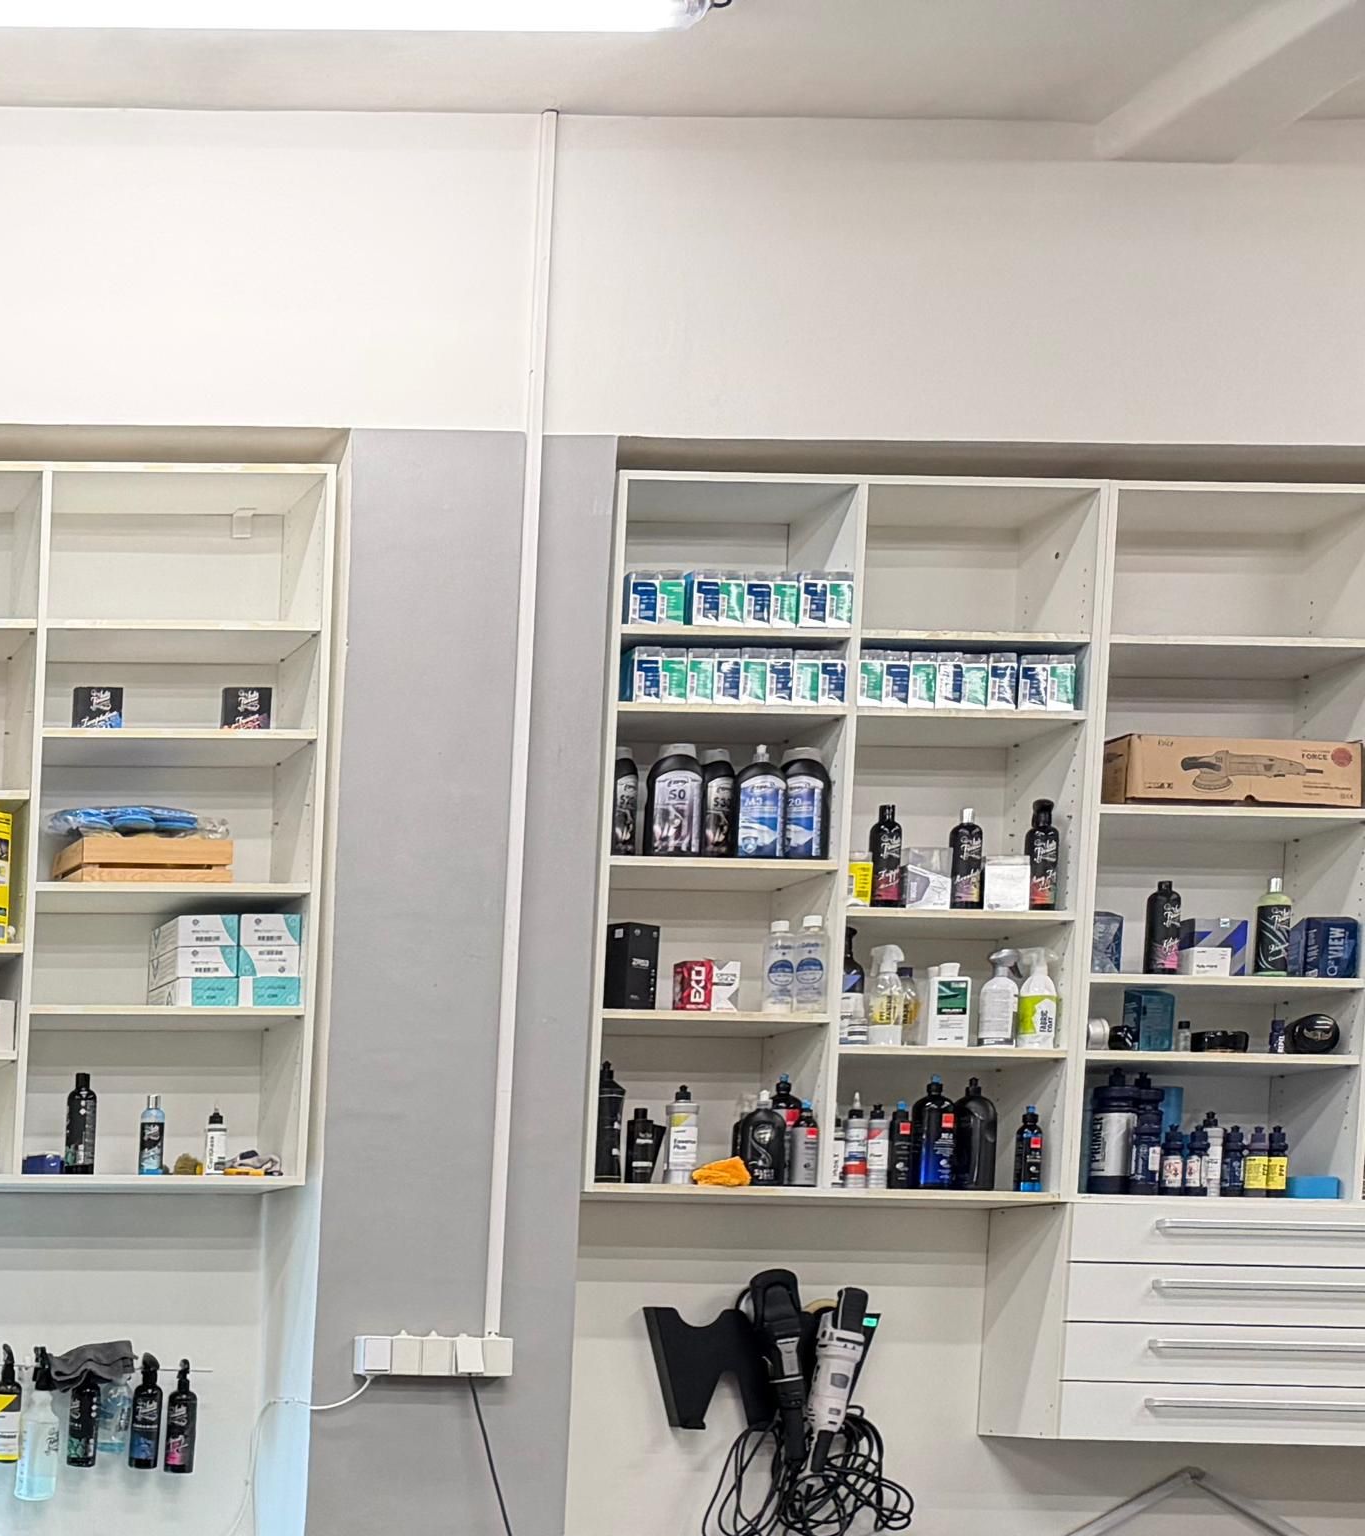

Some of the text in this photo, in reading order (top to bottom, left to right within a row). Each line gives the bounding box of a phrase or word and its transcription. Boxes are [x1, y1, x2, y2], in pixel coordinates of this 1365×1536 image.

[1302, 753, 1328, 761] FORCE
[1328, 927, 1346, 959] VIEW
[690, 966, 706, 1002] EXO
[1039, 1010, 1048, 1033] FABRIC
[1090, 1116, 1104, 1162] PRIMER
